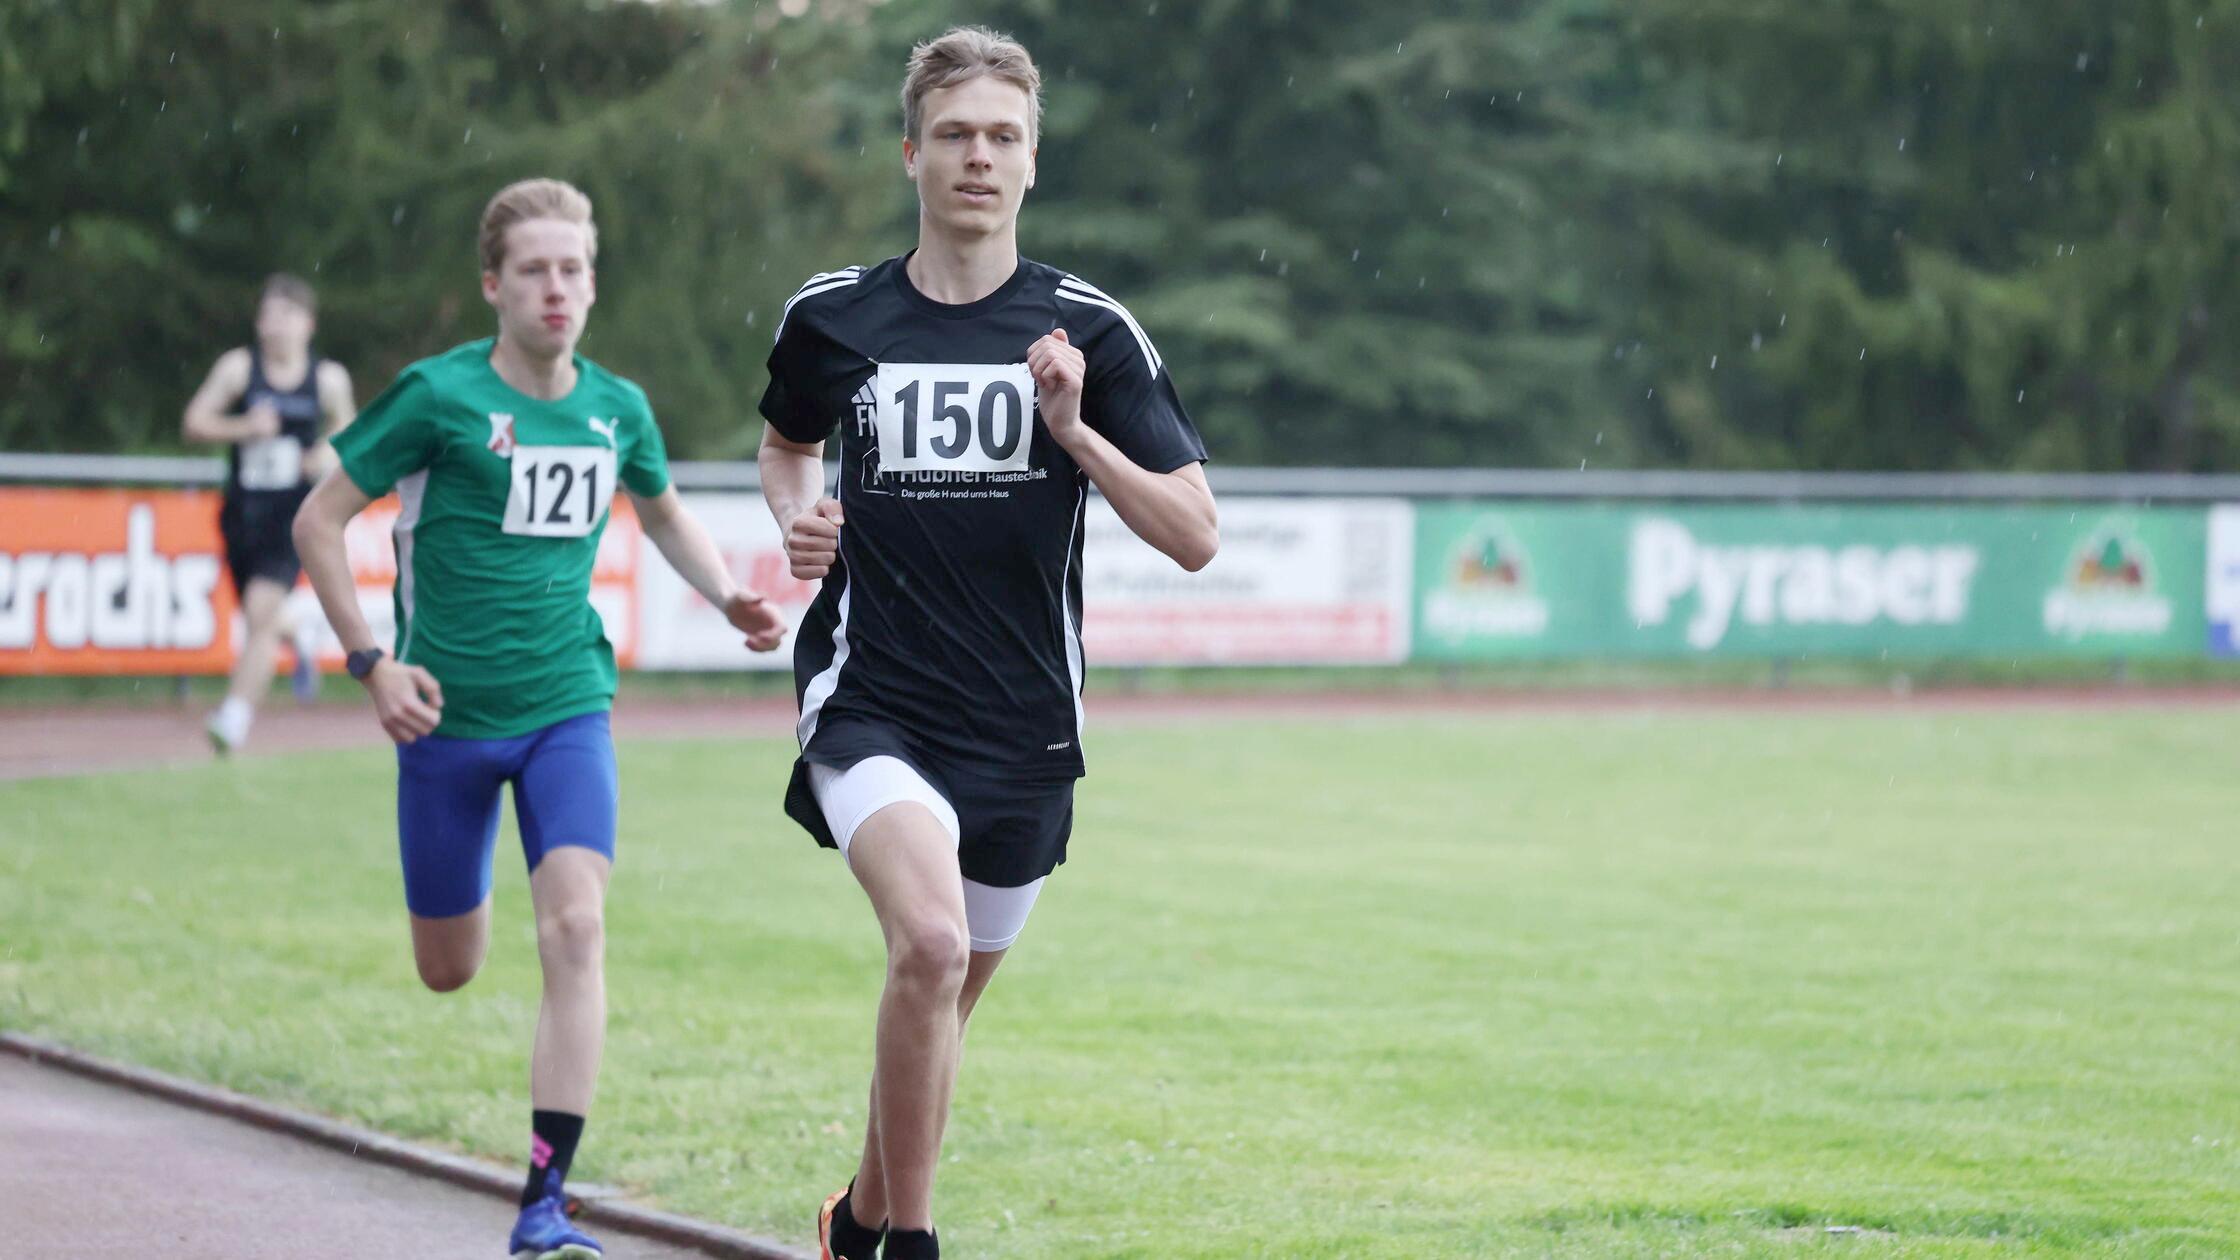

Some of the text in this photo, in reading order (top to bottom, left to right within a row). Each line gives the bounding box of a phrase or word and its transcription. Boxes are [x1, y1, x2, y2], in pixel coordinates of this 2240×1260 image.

[895, 380, 1022, 460] 150
[525, 462, 598, 523] 121
[901, 489, 1009, 501] Das große H rund ums Haus
[986, 468, 1048, 483] Haustechnik
[1628, 520, 1978, 650] Pyraser
